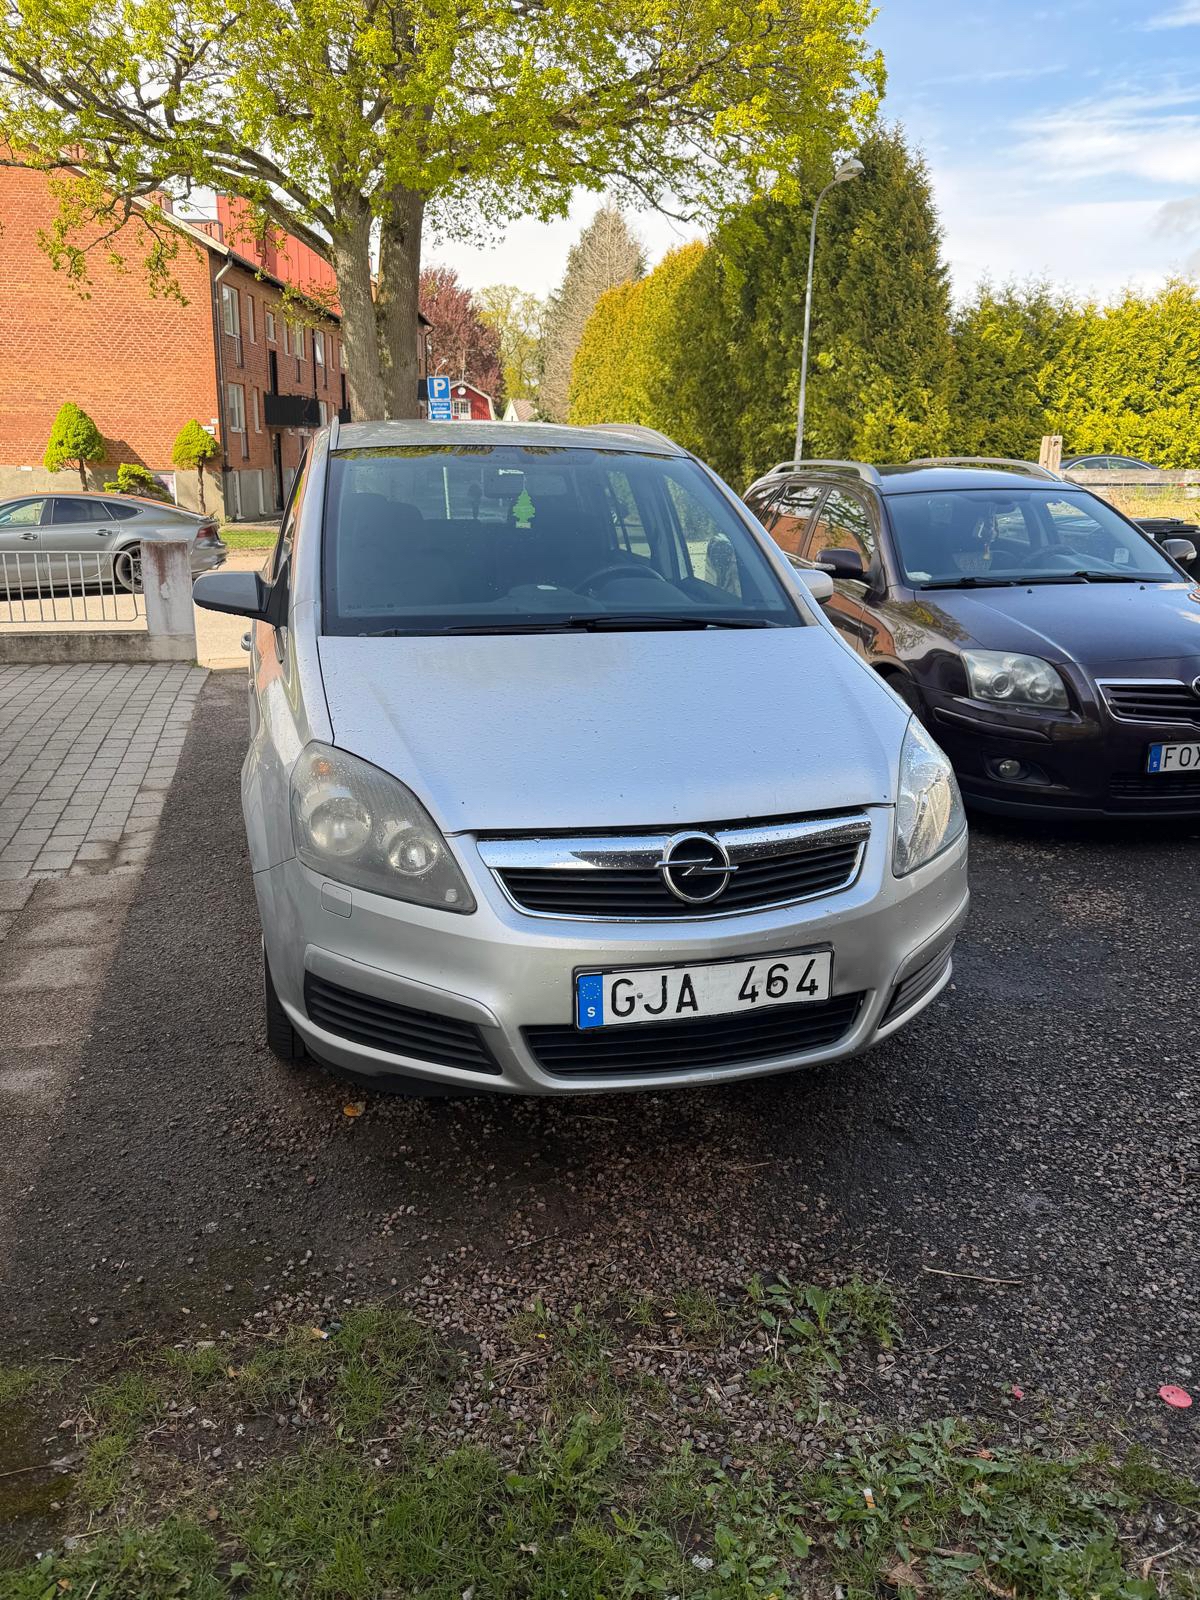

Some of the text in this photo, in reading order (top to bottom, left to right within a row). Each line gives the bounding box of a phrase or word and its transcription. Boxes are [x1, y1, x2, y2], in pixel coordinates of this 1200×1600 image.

[434, 379, 446, 397] P
[611, 959, 819, 1017] GJA 464
[587, 1006, 596, 1018] S
